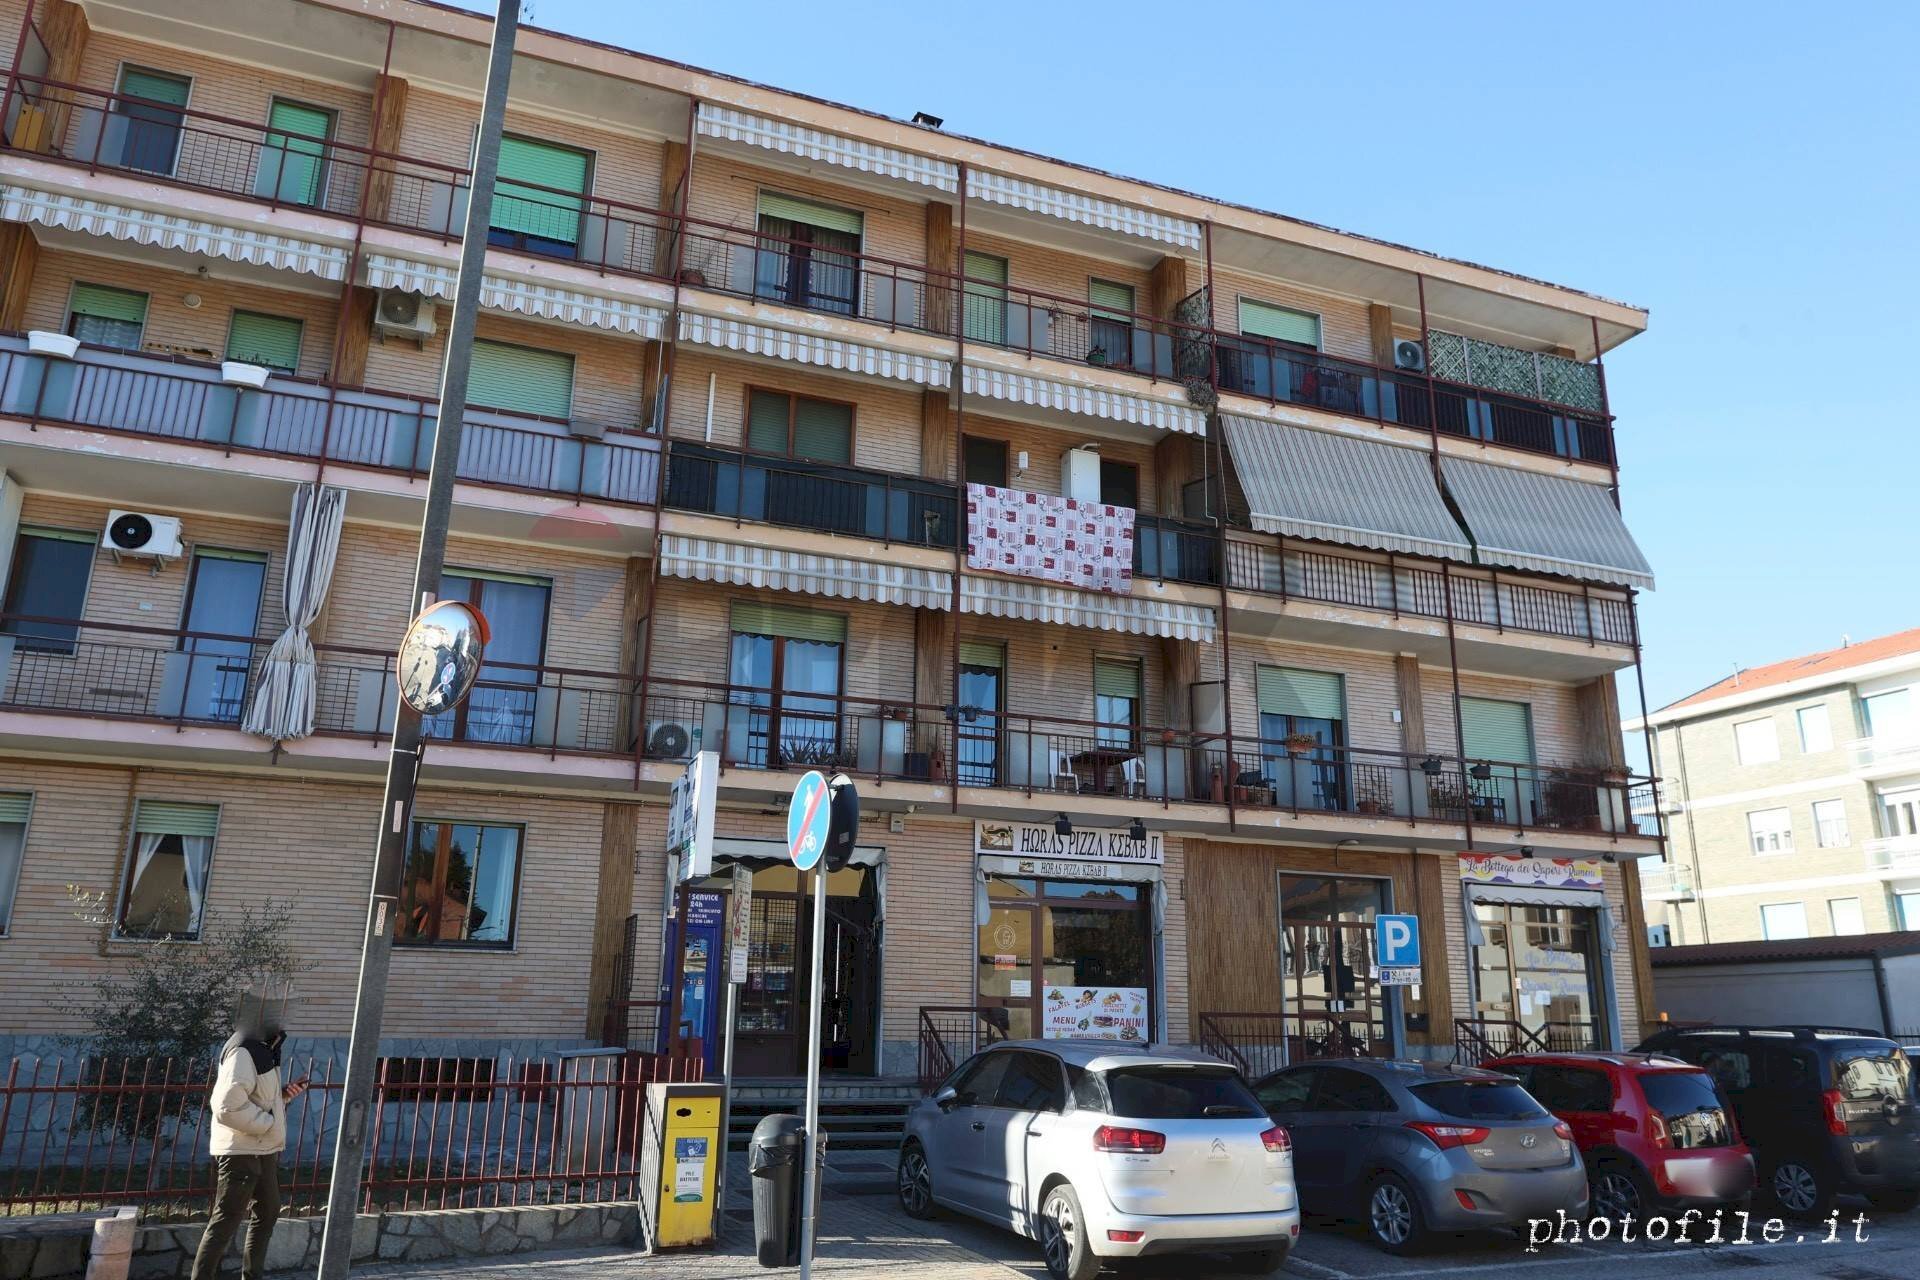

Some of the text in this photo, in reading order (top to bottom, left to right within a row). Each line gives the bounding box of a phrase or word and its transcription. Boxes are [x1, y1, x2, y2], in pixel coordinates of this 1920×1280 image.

[1067, 831, 1103, 856] PIZZA
[1063, 863, 1080, 875] PIZZA
[1465, 857, 1480, 874] La
[1481, 858, 1514, 880] Bottega
[1517, 863, 1530, 874] dei
[691, 893, 719, 901] SERVICE
[1385, 920, 1411, 961] P
[1052, 1016, 1077, 1024] MENU
[1113, 1017, 1144, 1028] PANINI
